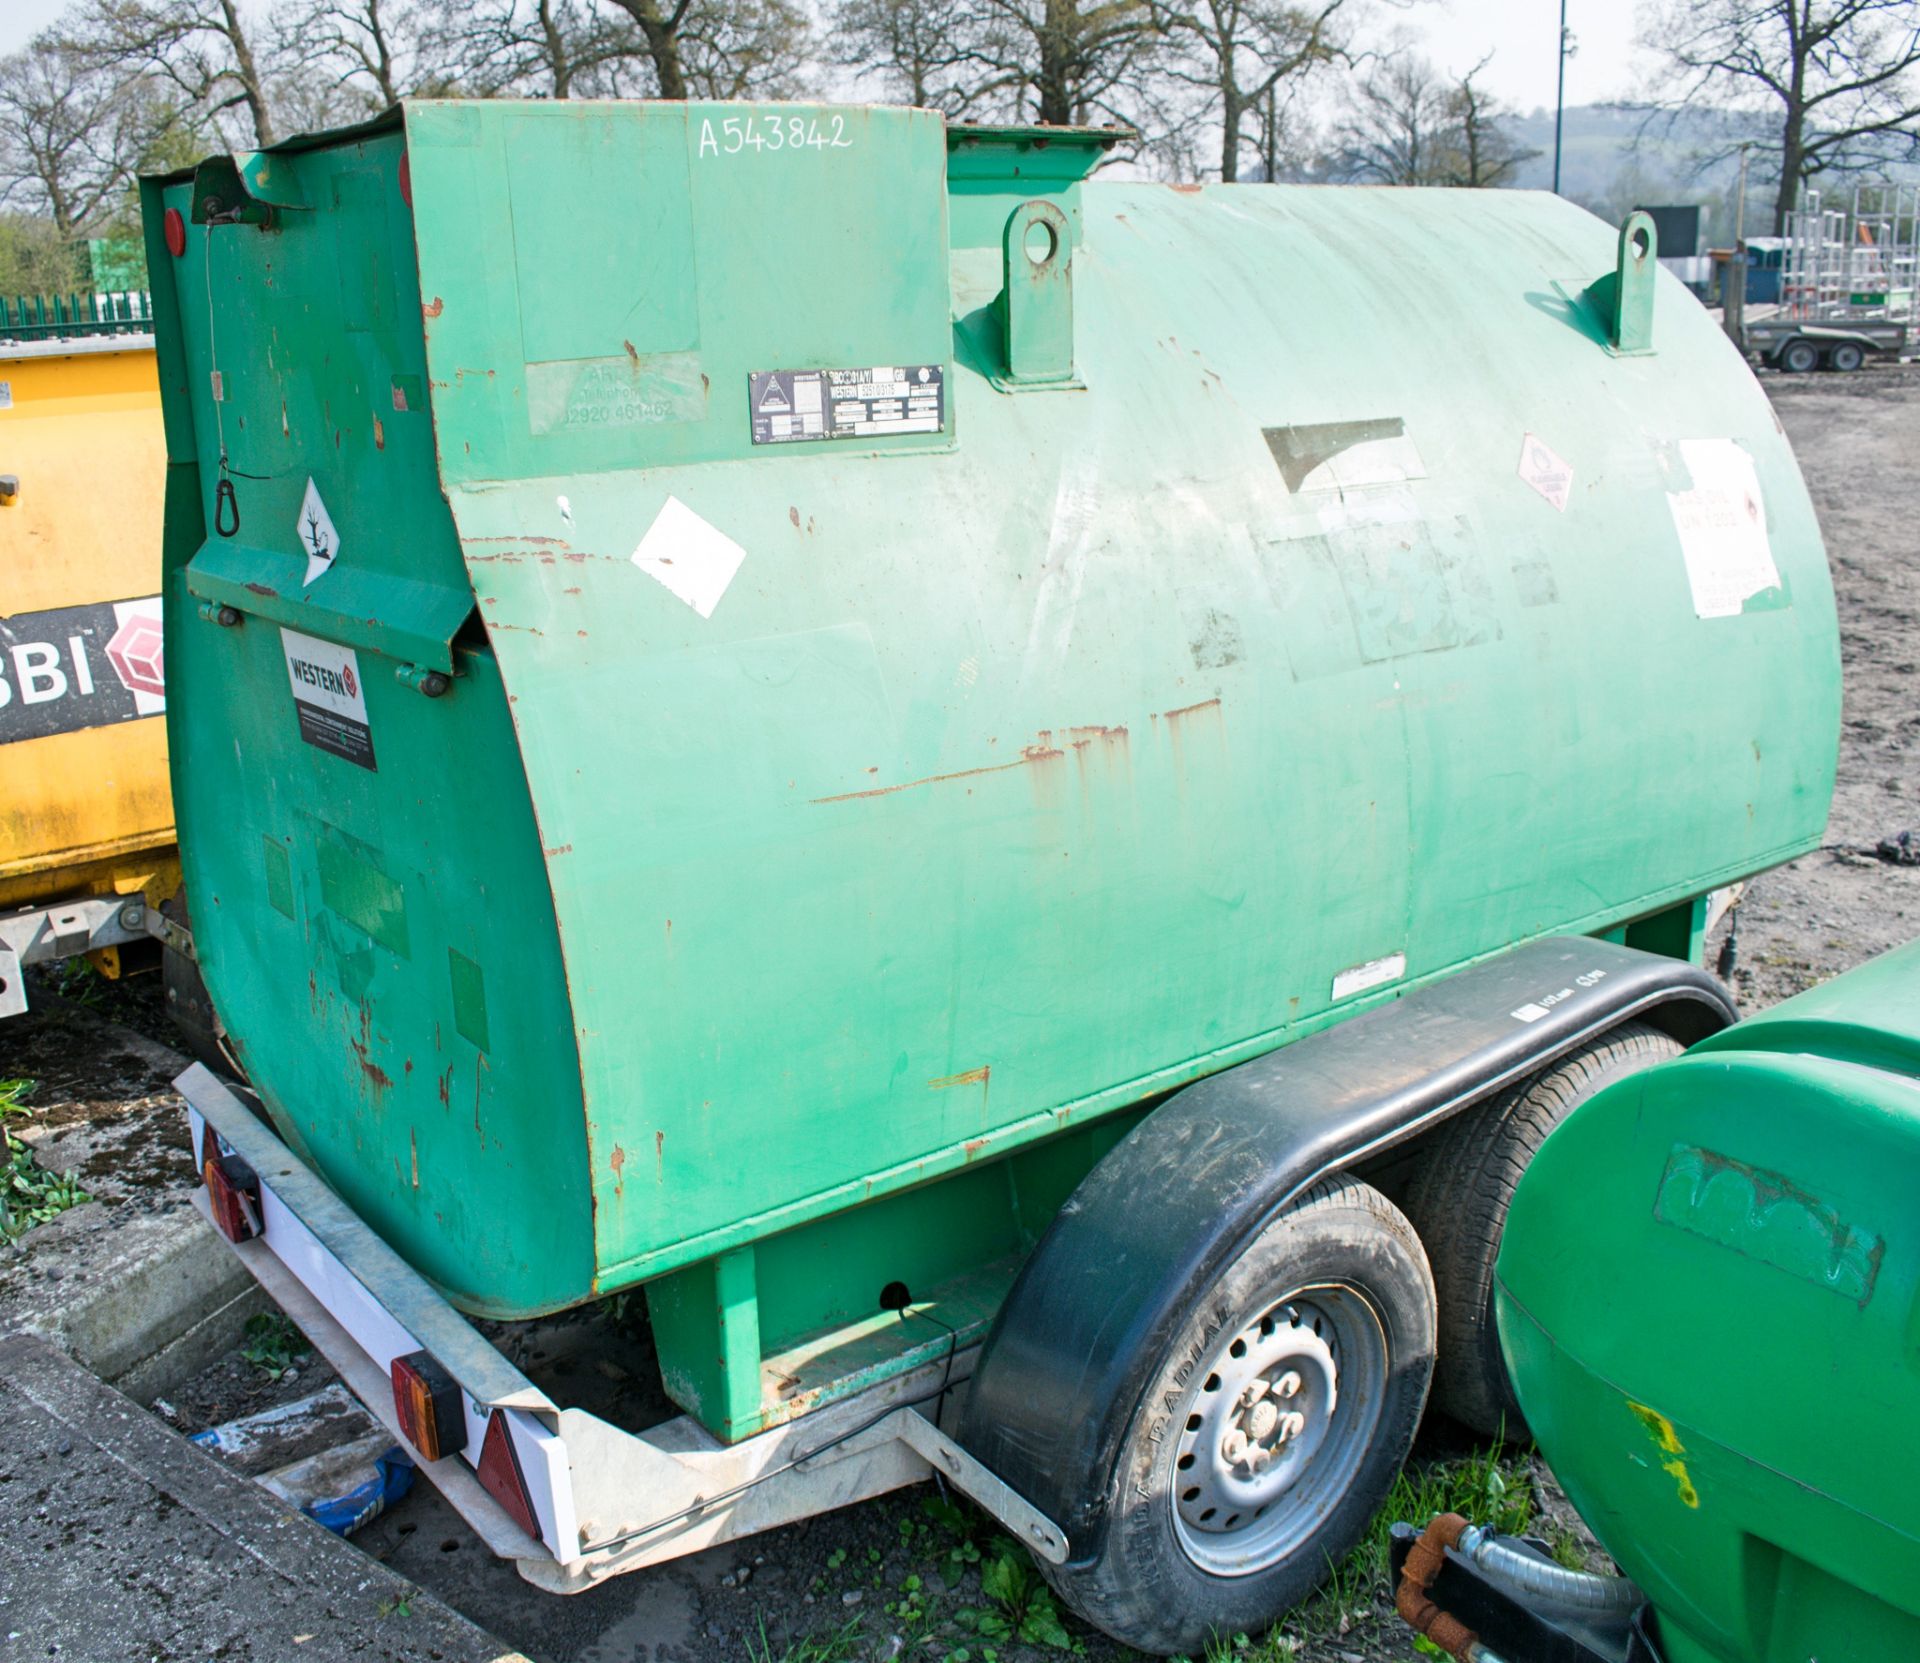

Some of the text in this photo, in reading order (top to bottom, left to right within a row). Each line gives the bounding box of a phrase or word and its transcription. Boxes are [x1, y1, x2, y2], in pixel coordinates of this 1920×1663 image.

[699, 114, 854, 159] A543842
[830, 385, 857, 399] WESTERN
[0, 635, 95, 710] BI
[290, 657, 346, 696] WESTERN
[1149, 1310, 1232, 1445] RADIAL
